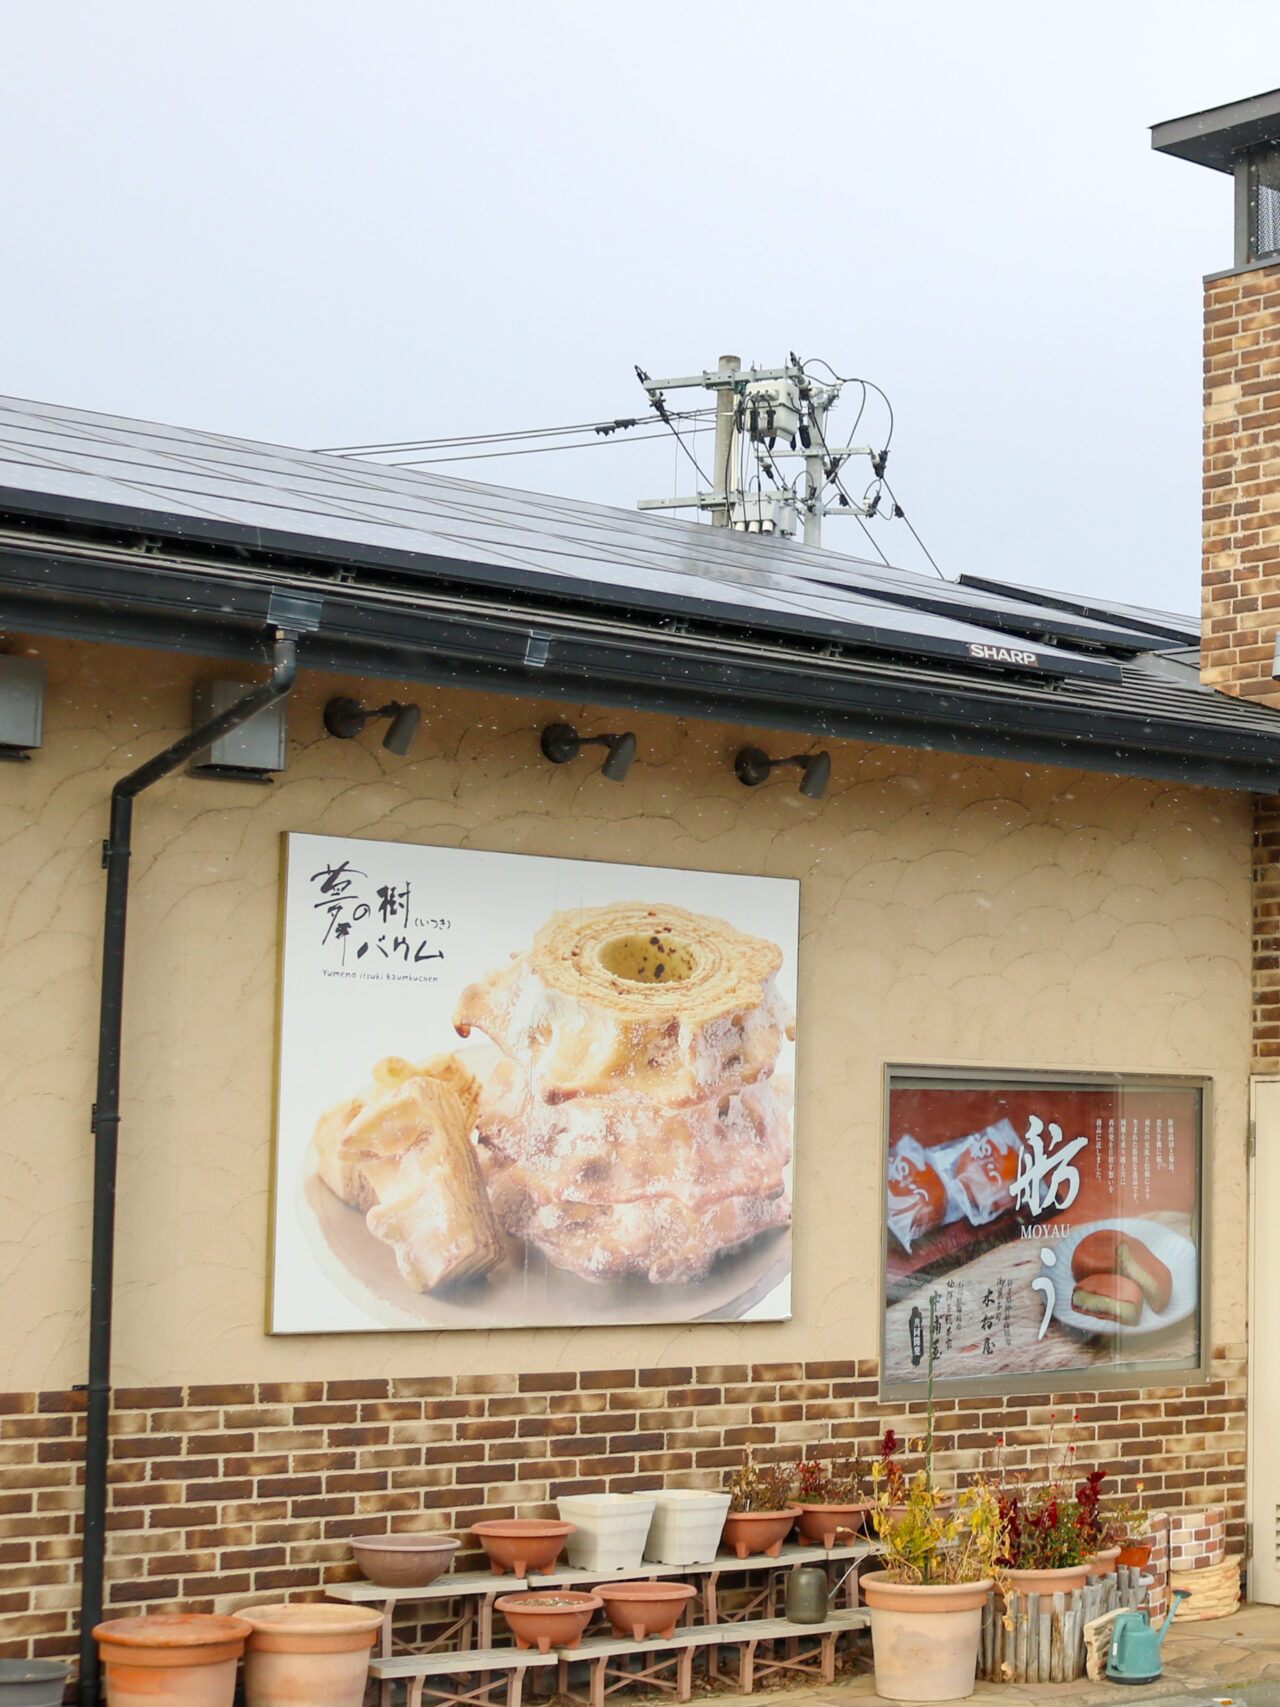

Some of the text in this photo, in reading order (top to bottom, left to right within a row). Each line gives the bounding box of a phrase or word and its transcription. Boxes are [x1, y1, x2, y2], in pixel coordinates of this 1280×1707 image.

[970, 643, 1036, 665] SHARP
[357, 935, 444, 962] バウム
[322, 969, 357, 979] Yumeno
[1020, 1223, 1071, 1240] MOYAU
[980, 1288, 996, 1355] 木村屋
